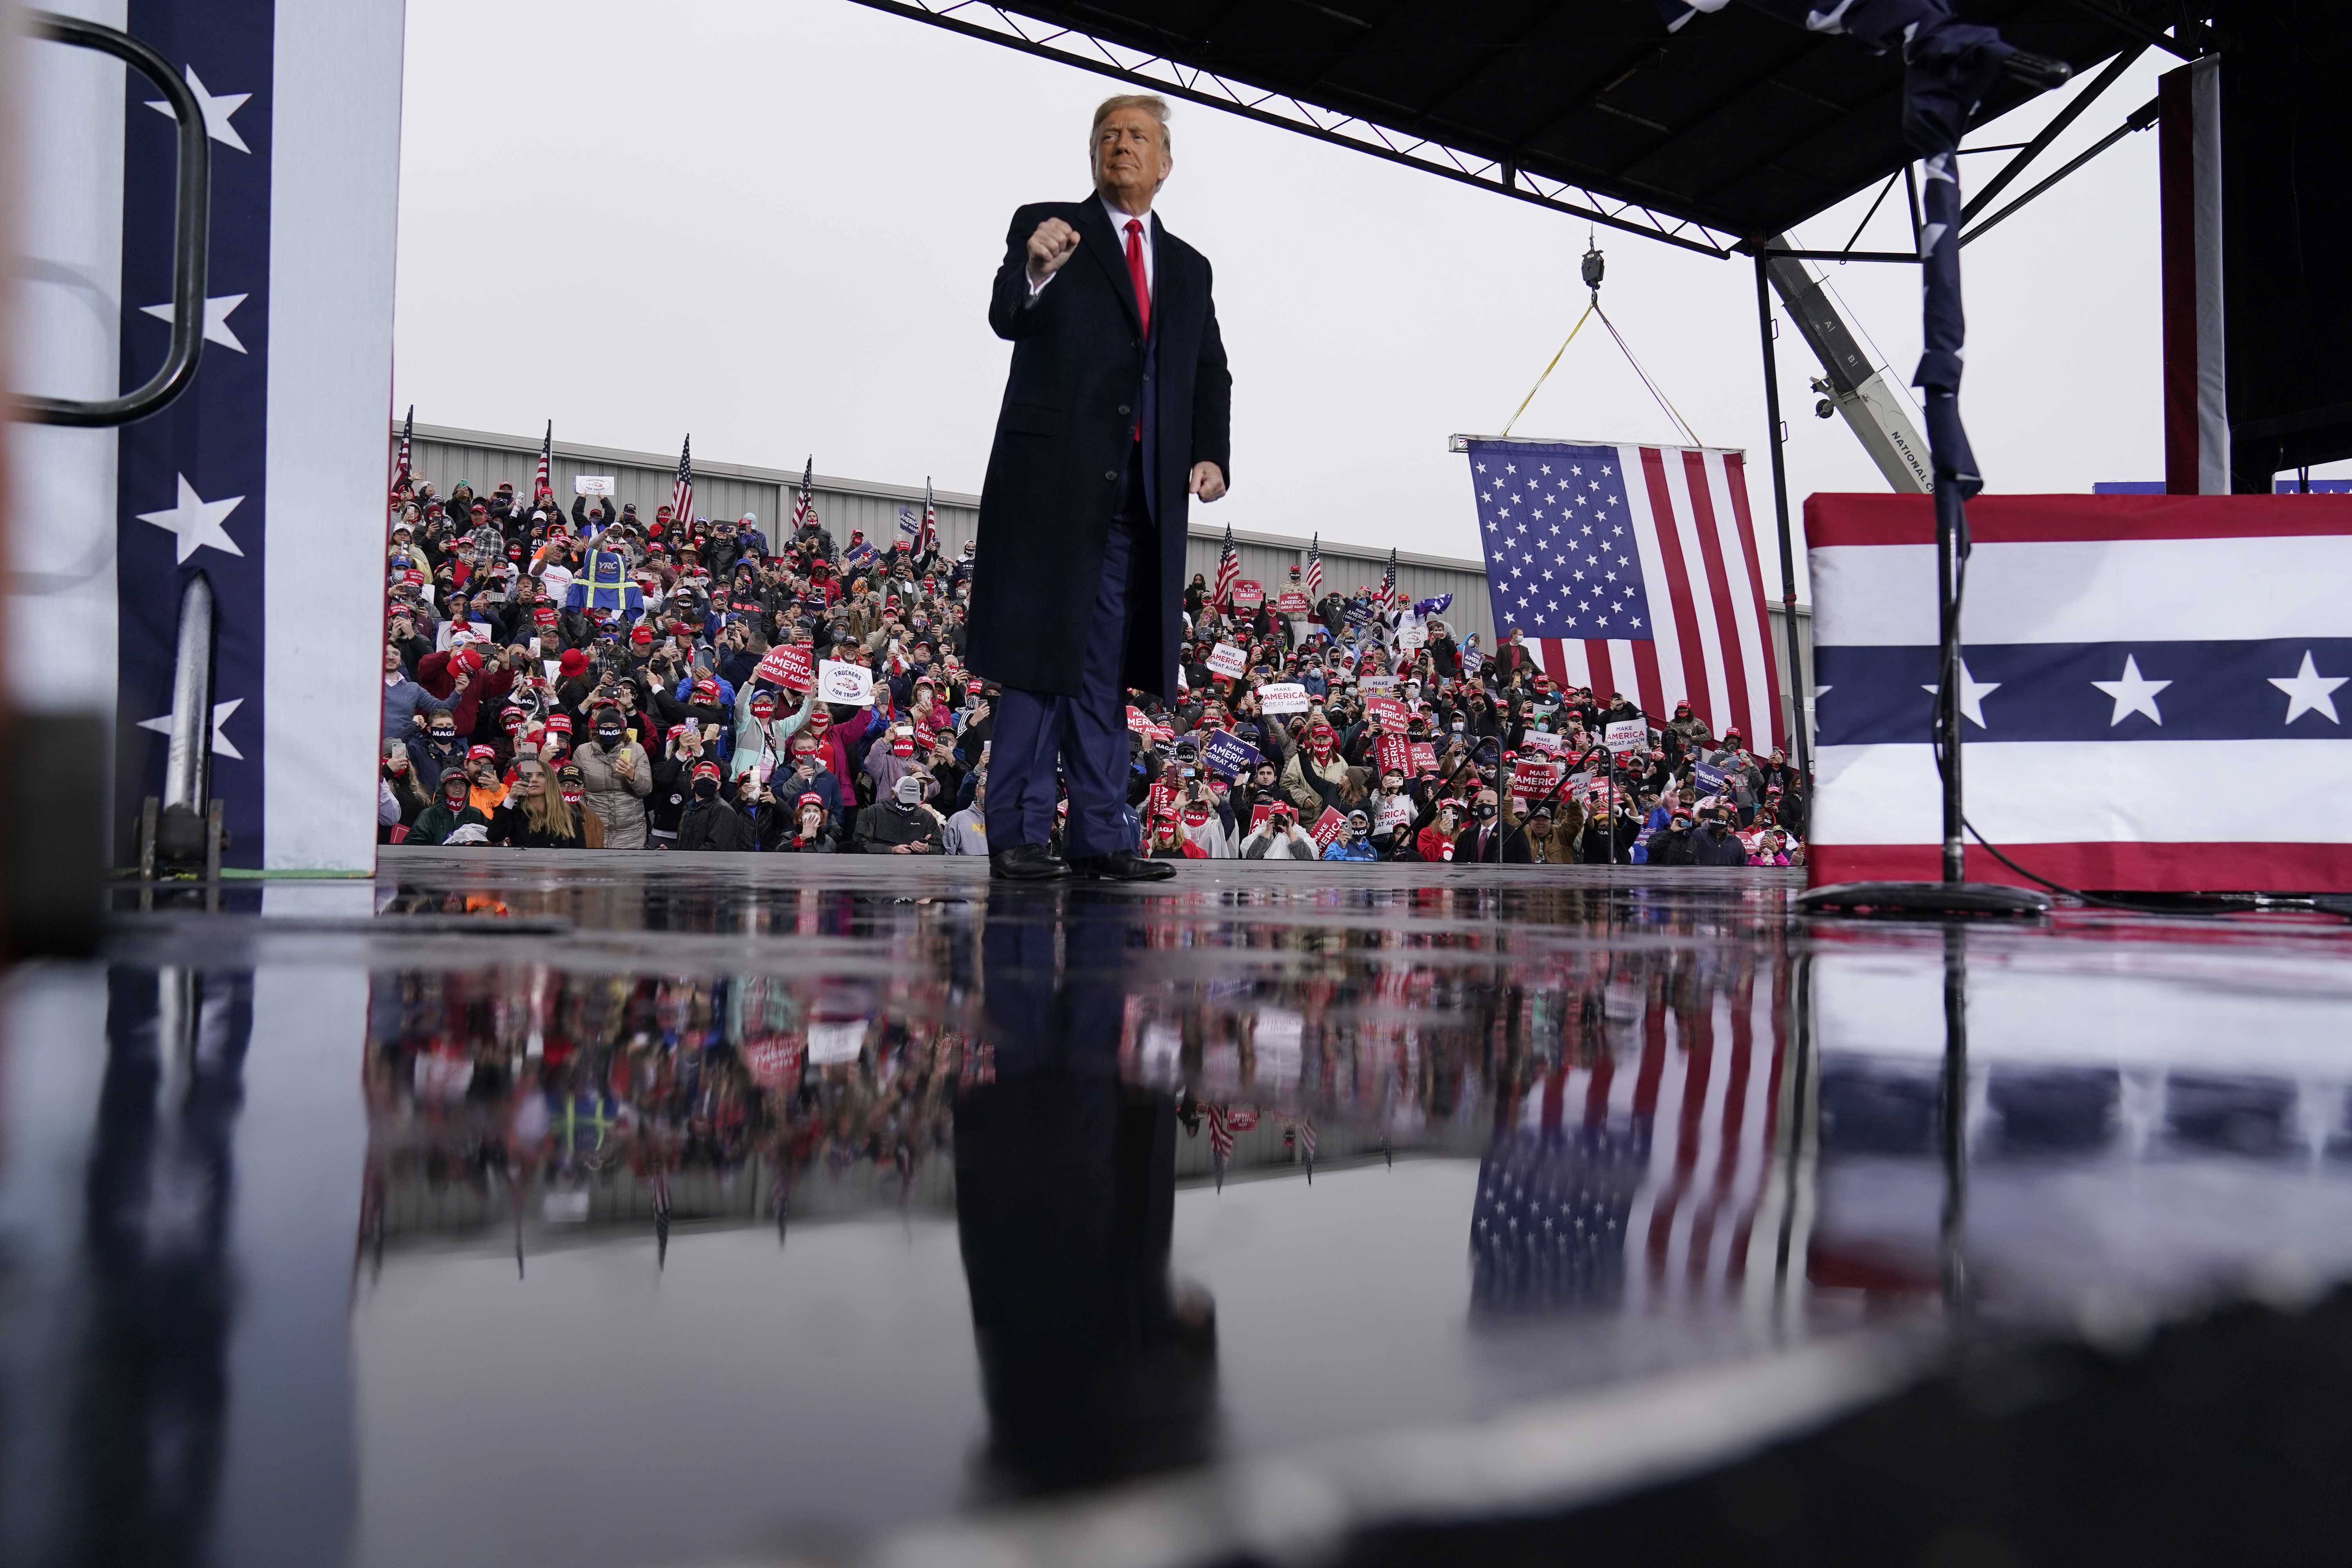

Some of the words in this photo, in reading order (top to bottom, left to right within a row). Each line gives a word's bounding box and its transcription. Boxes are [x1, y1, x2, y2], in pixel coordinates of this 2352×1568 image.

[1891, 431, 1926, 482] NATIONAL
[901, 514, 920, 528] AMERICA
[1347, 610, 1370, 621] AMERICA
[783, 651, 806, 663] MAKE
[1212, 653, 1242, 666] AMERICA
[765, 655, 812, 677] AMERICA
[1225, 665, 1242, 673] AGAIN
[762, 664, 788, 678] GREAT
[788, 674, 811, 686] AGAIN
[834, 670, 862, 681] TRUCKERS
[1264, 692, 1304, 700] AMERICA
[1381, 702, 1397, 711] MAKE
[1369, 708, 1405, 722] AMERICA
[1608, 731, 1644, 740] AMERICA
[483, 746, 495, 754] AMERICA
[1226, 742, 1245, 755] MAKE
[1207, 752, 1229, 766] GREAT
[1382, 747, 1390, 767] MAKE
[1401, 755, 1409, 777] GREAT
[1698, 769, 1724, 784] Workers
[1374, 809, 1406, 820] MERICA
[1314, 822, 1329, 842] MAKE
